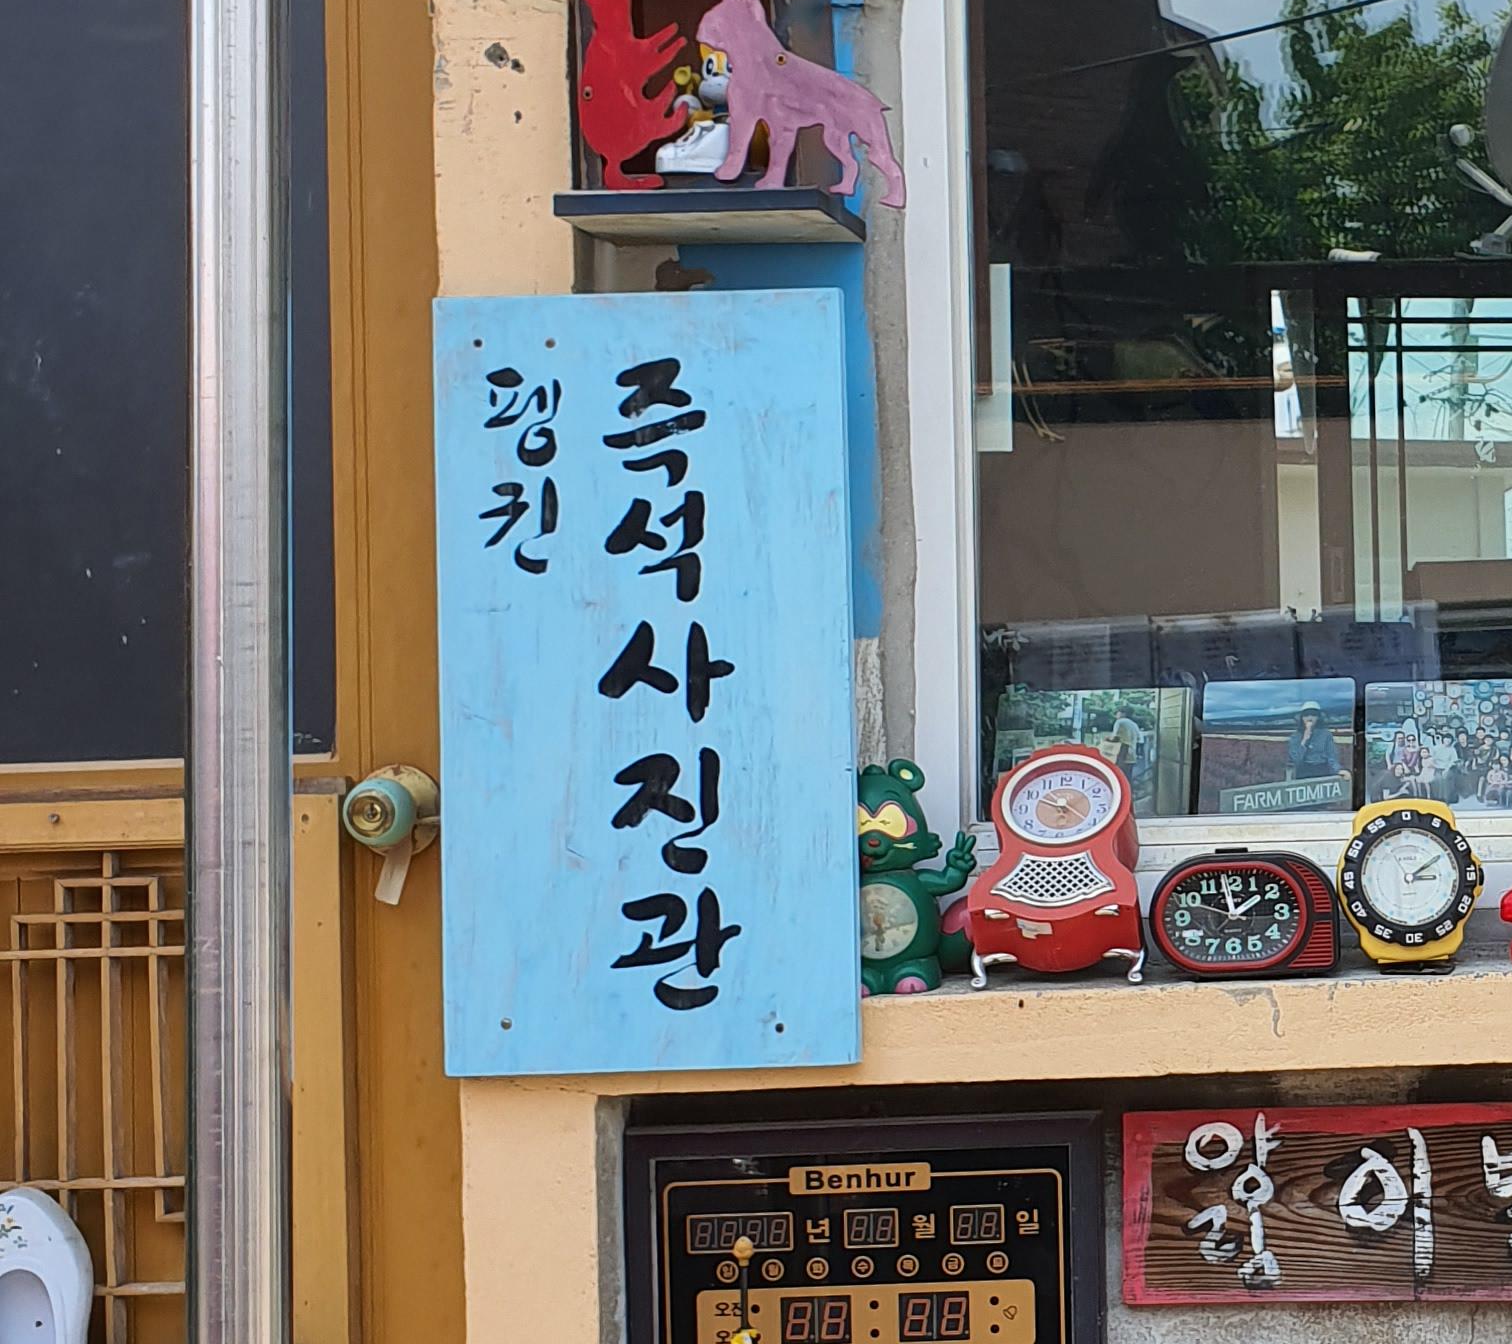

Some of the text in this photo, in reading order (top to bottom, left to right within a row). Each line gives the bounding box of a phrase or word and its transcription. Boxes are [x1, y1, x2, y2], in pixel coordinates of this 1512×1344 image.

[1233, 782, 1342, 810] FARM TOMITA
[804, 1169, 916, 1191] Benhur
[806, 1208, 1040, 1244] 년 월 일
